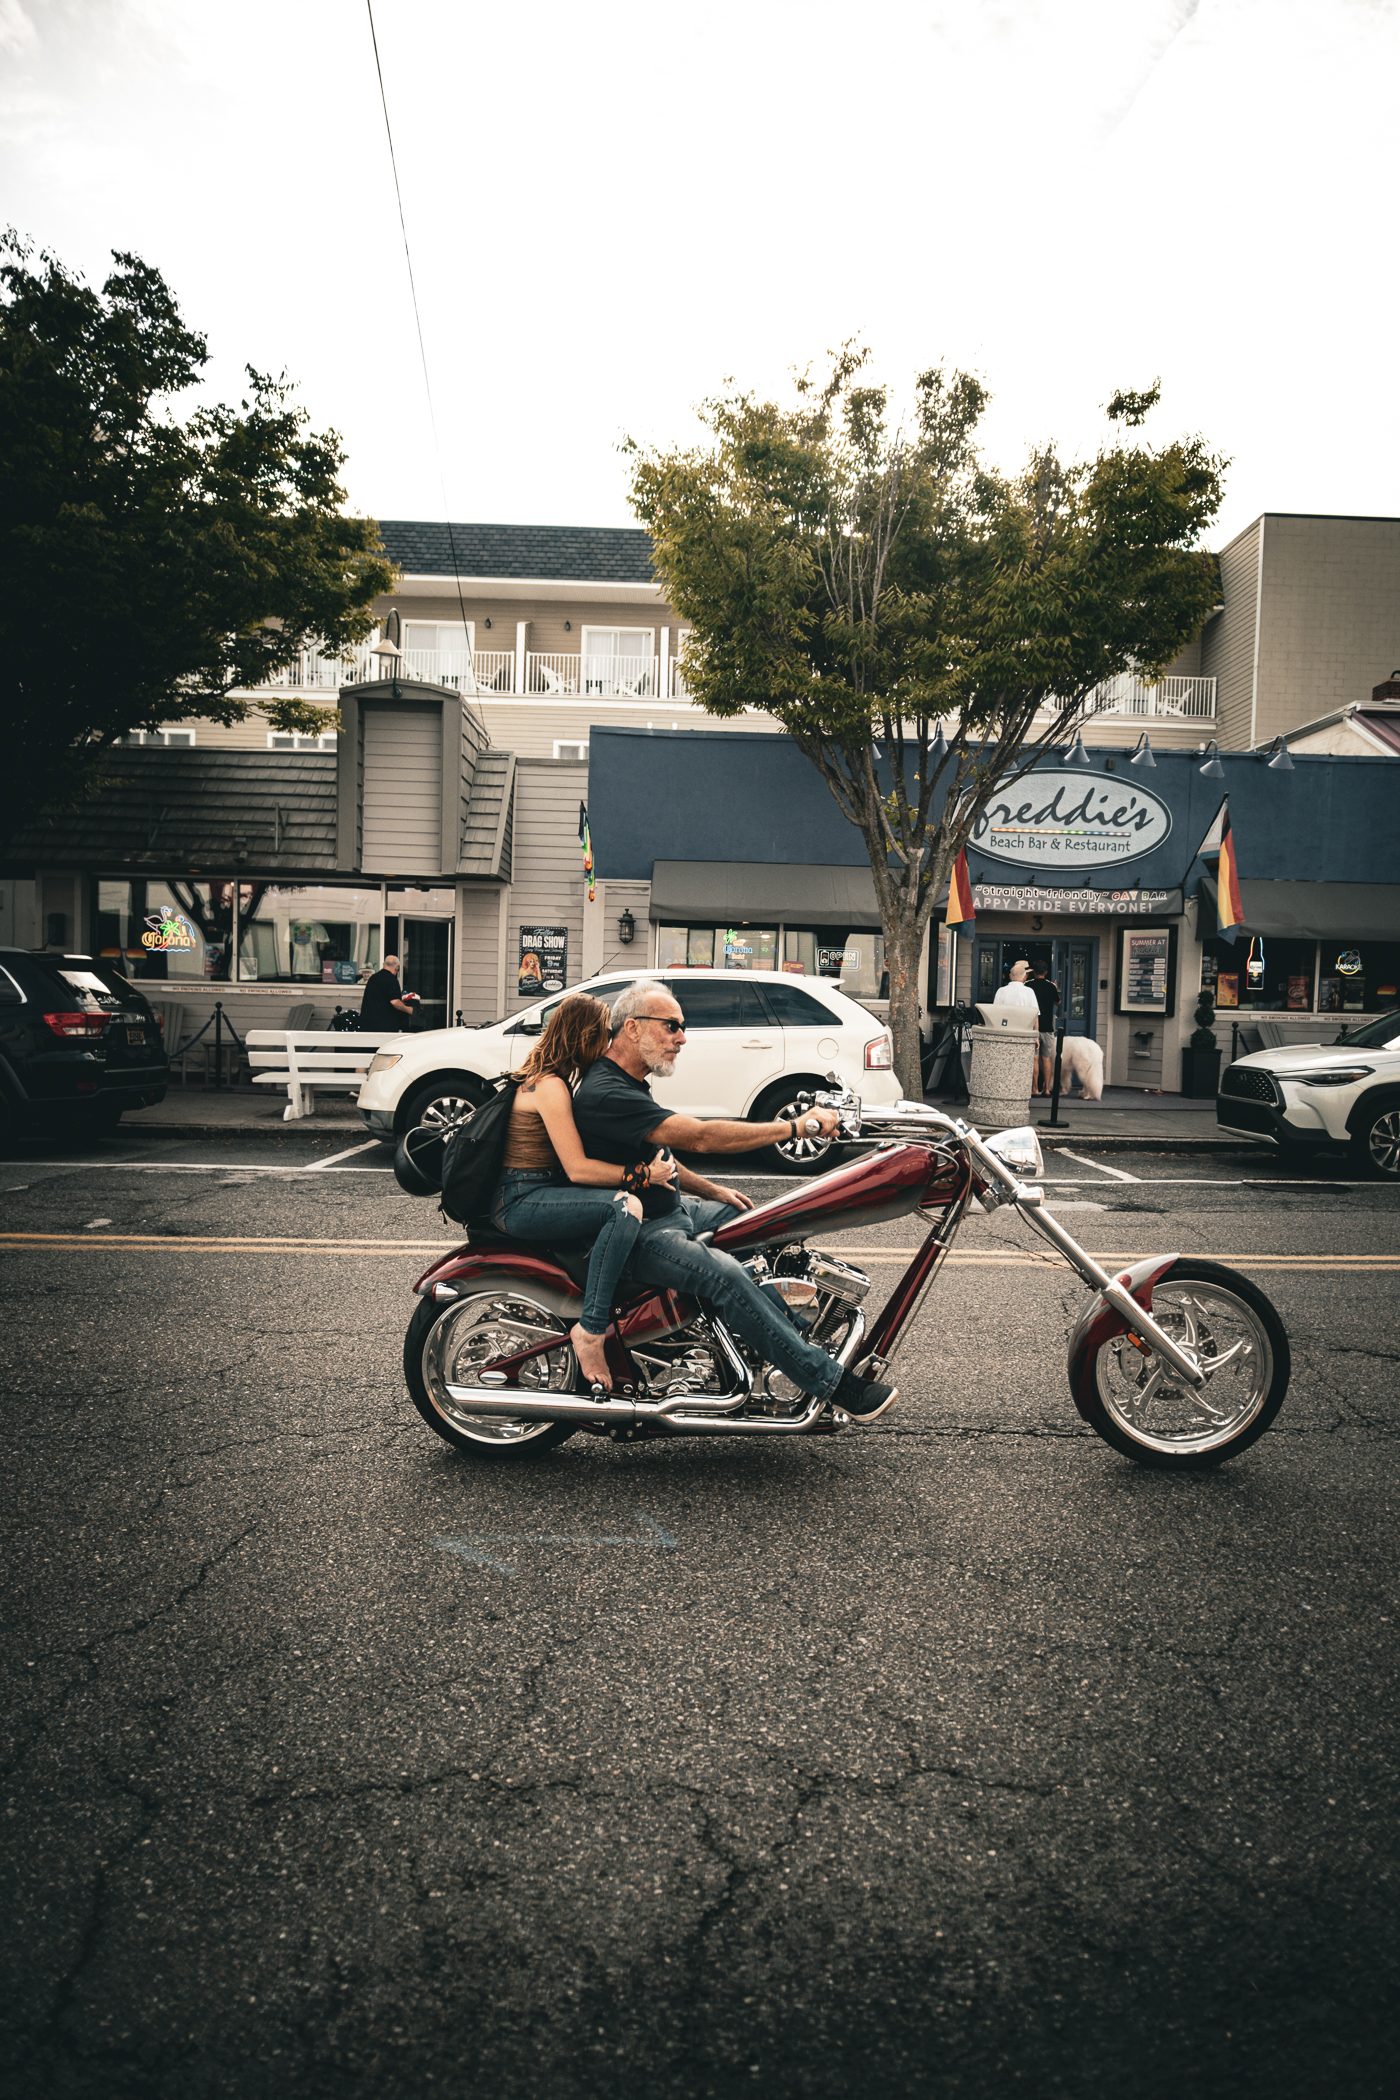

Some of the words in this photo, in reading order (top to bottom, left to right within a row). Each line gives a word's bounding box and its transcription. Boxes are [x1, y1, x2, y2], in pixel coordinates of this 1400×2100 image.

[990, 835, 1024, 849] Beach
[1028, 836, 1048, 849] Bar
[1050, 838, 1060, 850] &
[1065, 838, 1131, 852] Restaurant
[1111, 890, 1138, 901] GAY
[1141, 891, 1168, 901] BAR
[973, 897, 1011, 909] APPY
[1018, 899, 1061, 912] PRIDE
[1069, 902, 1152, 913] EVERYONE!
[1032, 915, 1043, 931] 3
[142, 931, 191, 949] Corona
[522, 935, 543, 948] DRAG
[543, 936, 565, 948] SHOW
[723, 944, 753, 956] Corona
[830, 951, 856, 961] OPEN
